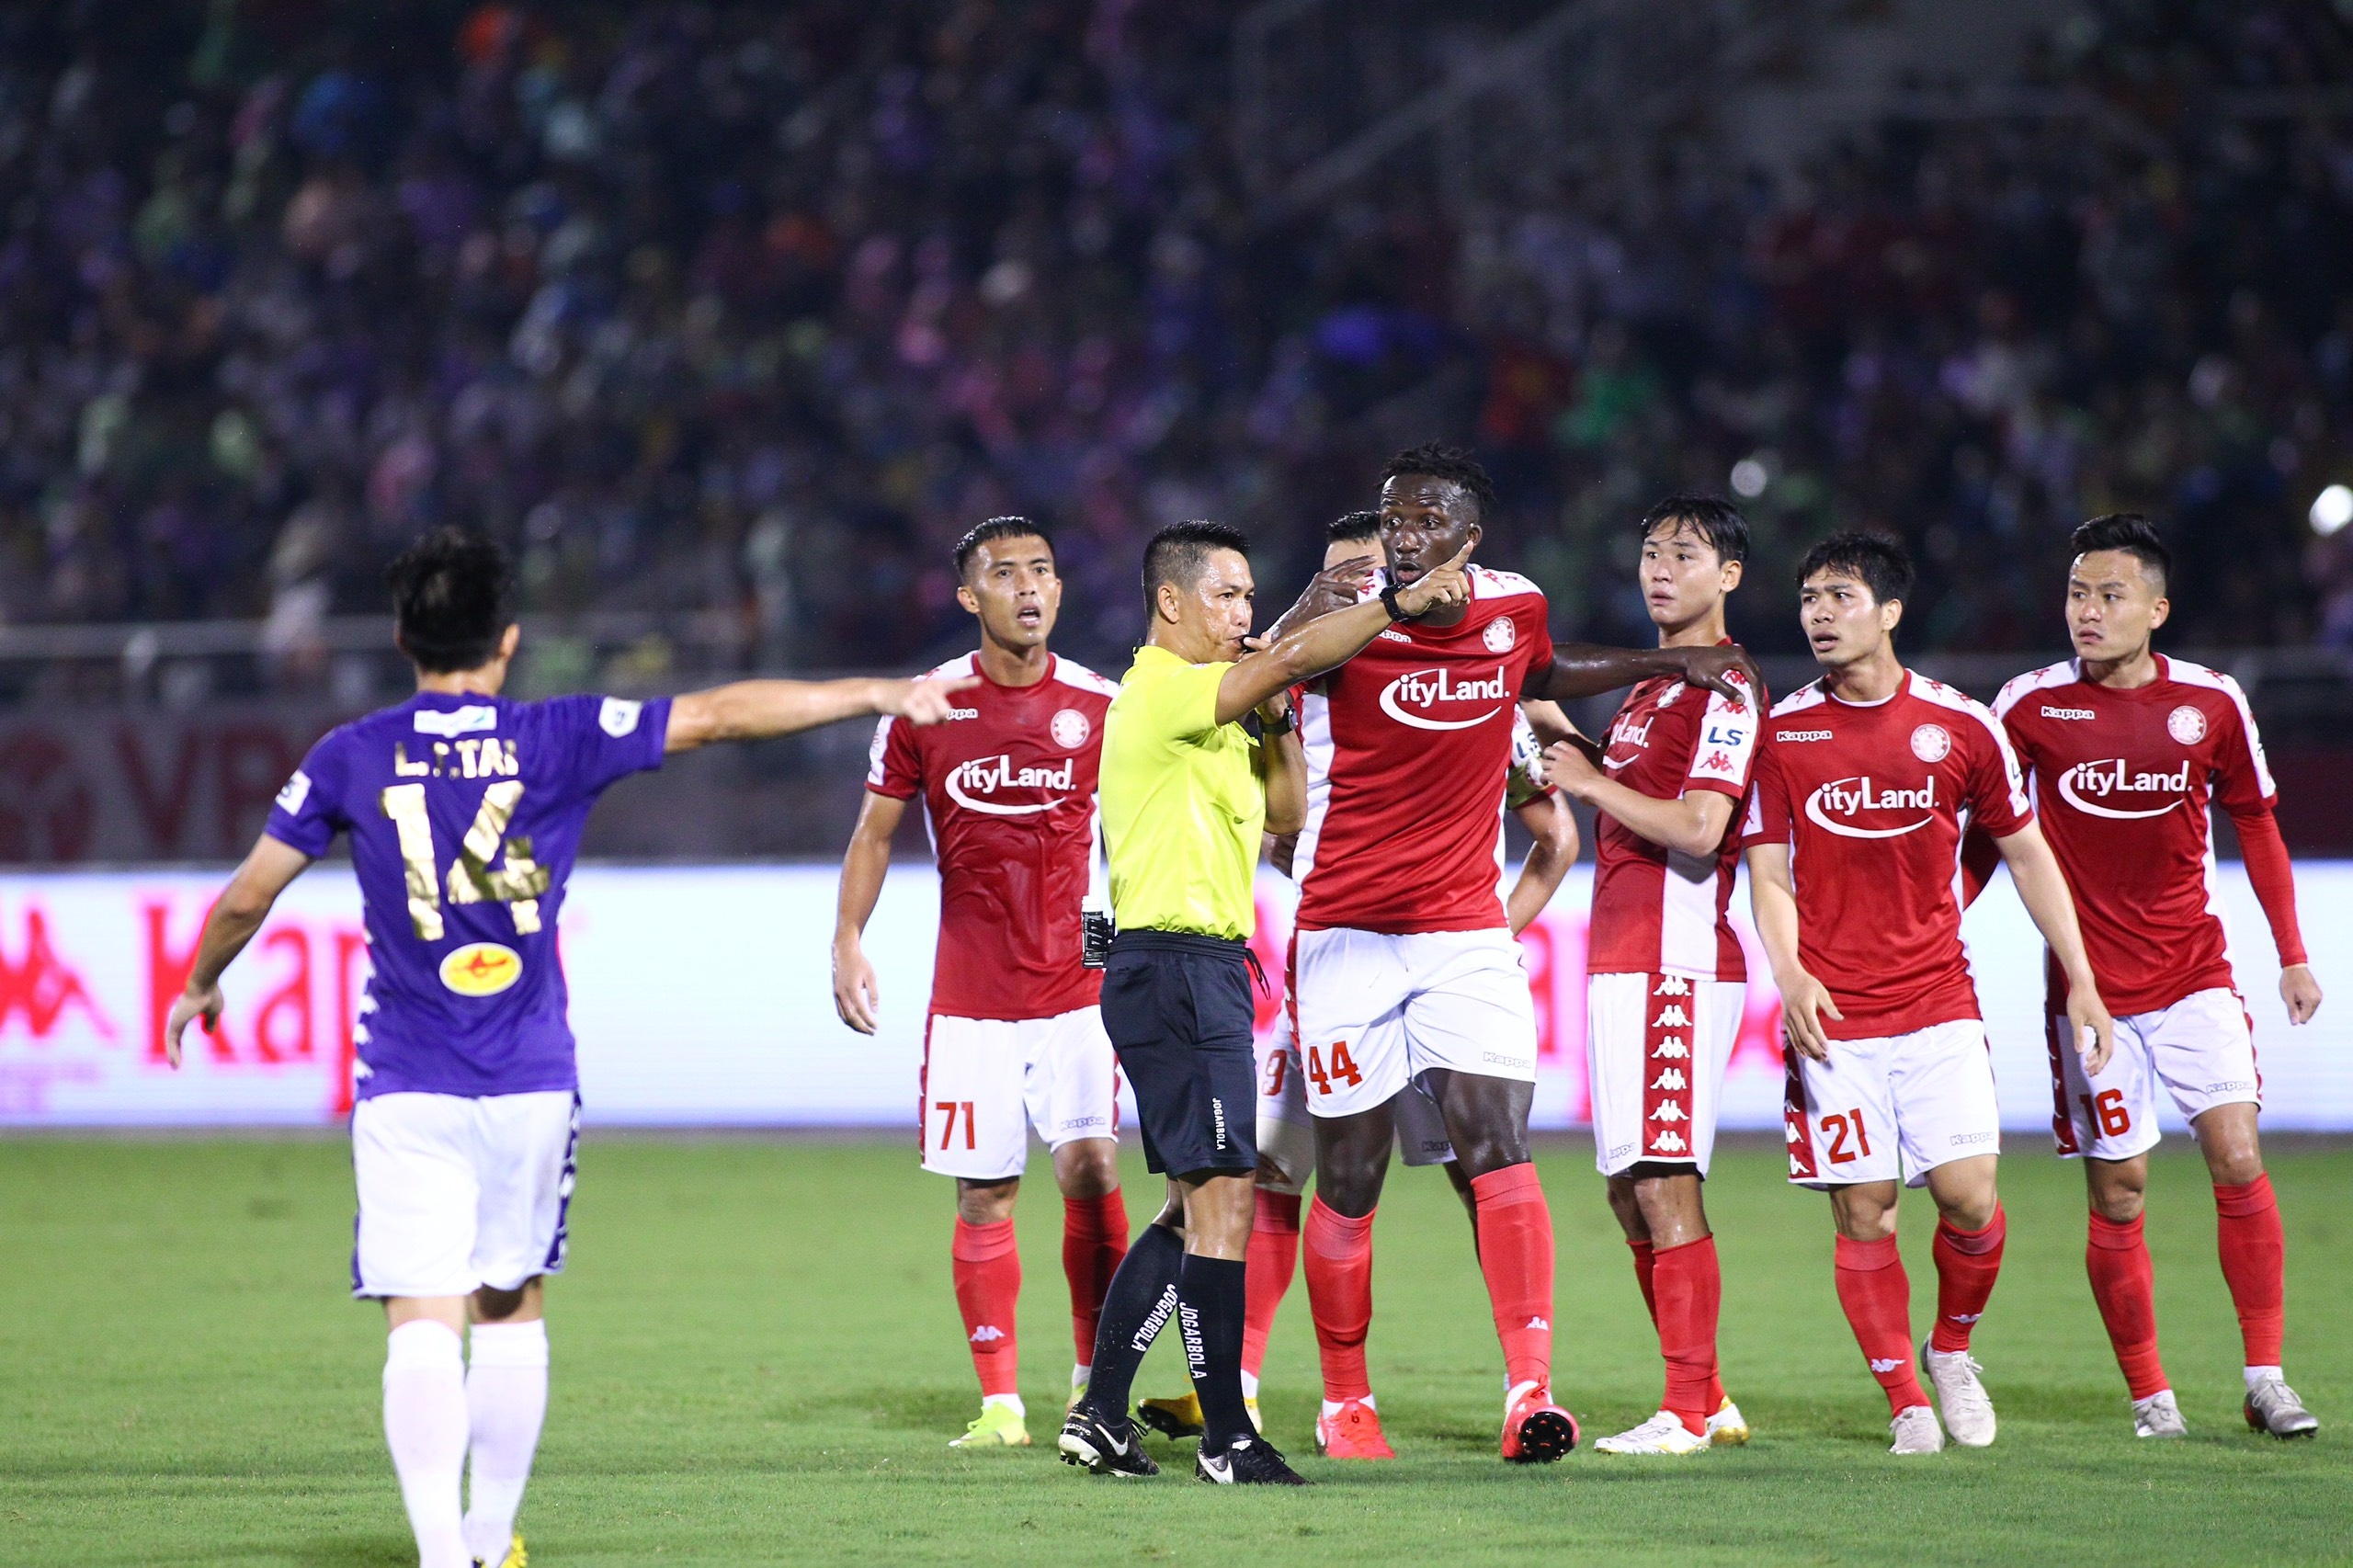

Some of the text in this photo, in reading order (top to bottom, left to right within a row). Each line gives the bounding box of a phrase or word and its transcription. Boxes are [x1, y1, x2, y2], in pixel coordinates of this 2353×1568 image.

[1379, 628, 1413, 644] ppa
[947, 708, 979, 721] ppa
[2040, 706, 2096, 721] Kappa
[1707, 726, 1745, 746] LS
[1776, 730, 1834, 743] Kappa
[379, 779, 551, 941] 14
[1308, 1040, 1363, 1096] 44
[1483, 1051, 1531, 1069] Kappa
[2206, 1079, 2255, 1094] Kappa
[1059, 1114, 1106, 1132] Kappa
[2078, 1088, 2131, 1138] 16
[935, 1101, 976, 1151] 71
[1211, 1097, 1226, 1151] JOGARBOLA
[1820, 1107, 1871, 1165] 21
[1949, 1131, 1995, 1147] Kappa
[1131, 1283, 1178, 1353] JOGARBOLA
[1178, 1301, 1208, 1380] JOGARBOLA
